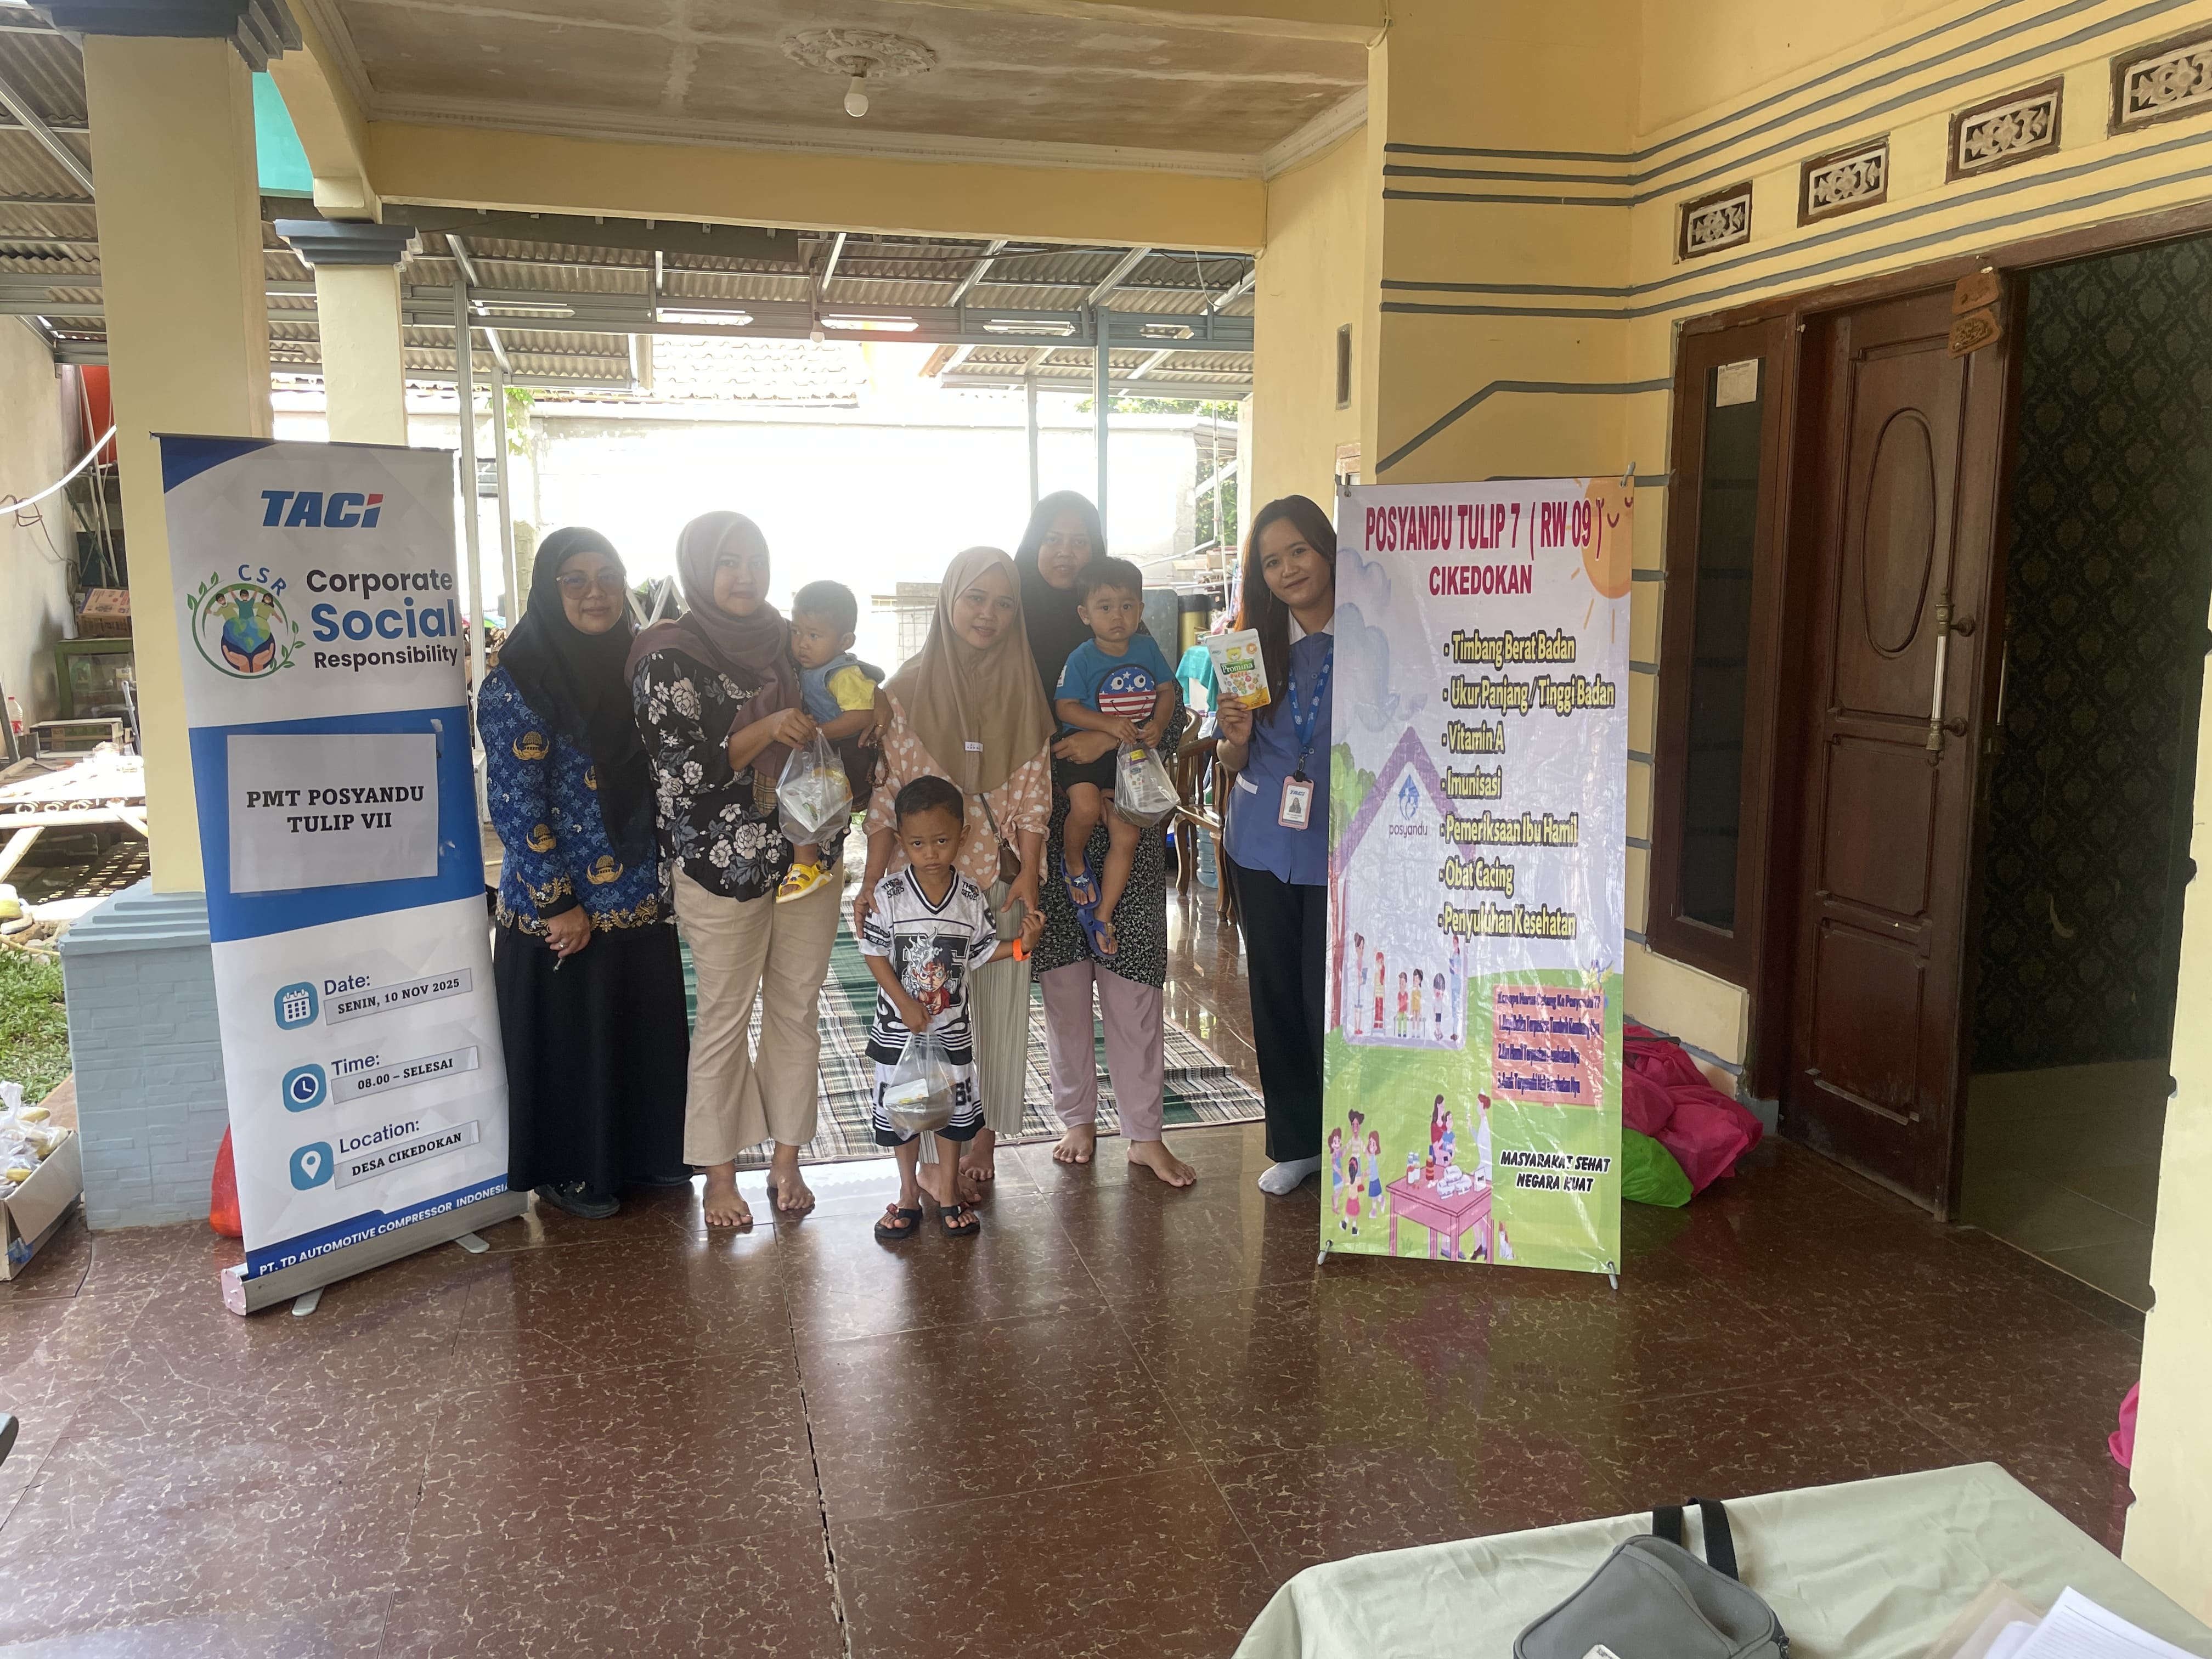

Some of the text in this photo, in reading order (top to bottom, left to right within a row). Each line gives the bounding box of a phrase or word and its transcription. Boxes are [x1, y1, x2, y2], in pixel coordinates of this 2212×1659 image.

[1365, 505, 1452, 551] POSYANDU
[1458, 503, 1506, 549] TULIP
[1511, 502, 1520, 548] 7
[1541, 500, 1567, 548] RW
[1572, 500, 1592, 547] 09
[306, 569, 453, 600] Corporate
[1429, 564, 1532, 596] CIKEDOKAN
[311, 596, 456, 642] Social
[314, 645, 458, 672] Responsibility
[1452, 628, 1576, 670] Timbang Berat Badan
[1221, 663, 1254, 674] Promina
[1451, 675, 1481, 708] Ukur
[1481, 674, 1529, 716] Panjang
[1538, 674, 1575, 716] Tinggi
[1576, 674, 1615, 709] Badan
[1448, 720, 1505, 754] Vitamin A
[247, 786, 424, 808] PMT POSYANDU
[1446, 765, 1502, 799] Imunisasi
[287, 812, 392, 833] TULIP VII
[1388, 821, 1428, 839] posyandu
[1446, 810, 1578, 847] Pemeriksaan Ibu Hamil
[1445, 855, 1514, 899] Obat Cacing
[1443, 901, 1576, 943] Penyuluhan Kesehatan
[324, 973, 371, 996] Date:
[337, 978, 460, 1015] SENIN, 10 NOV 2025
[331, 1053, 380, 1077] Time:
[358, 1073, 390, 1090] 08.00
[403, 1058, 453, 1079] SELESAI
[339, 1119, 420, 1153] Location:
[351, 1132, 462, 1177] DESA CIKEDOKAN
[1500, 1151, 1611, 1172] MASYARAKAT SEHAT
[1516, 1173, 1594, 1192] NEGARA KUAT
[259, 1261, 278, 1276] PT.
[280, 1254, 296, 1269] TD
[299, 1227, 376, 1261] AUTOMOTIVE
[377, 1201, 452, 1234] COMPRESSOR
